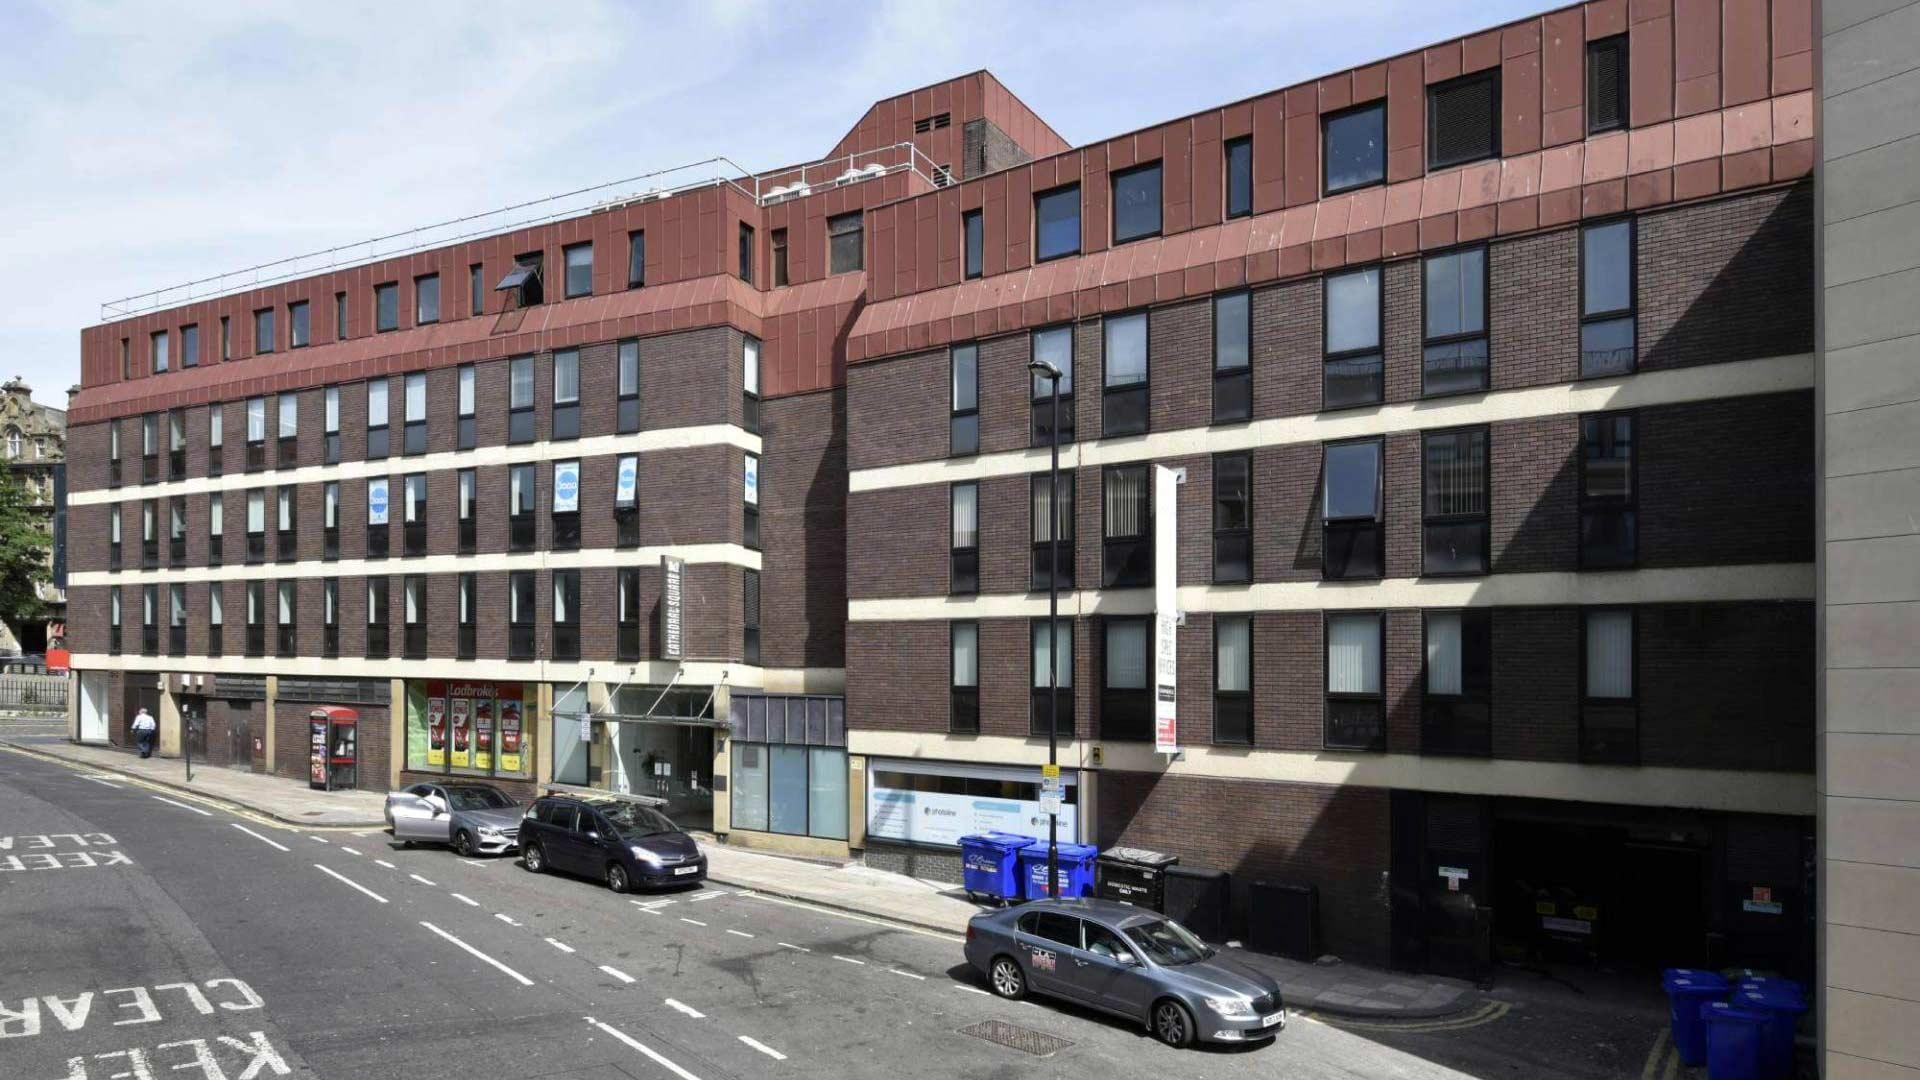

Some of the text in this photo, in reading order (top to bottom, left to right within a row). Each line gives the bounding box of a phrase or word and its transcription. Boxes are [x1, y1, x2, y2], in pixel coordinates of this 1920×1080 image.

[667, 572, 680, 655] CATHEDRAL SQUARE
[450, 683, 499, 697] Ladbrokes
[0, 978, 265, 1038] CLEAR
